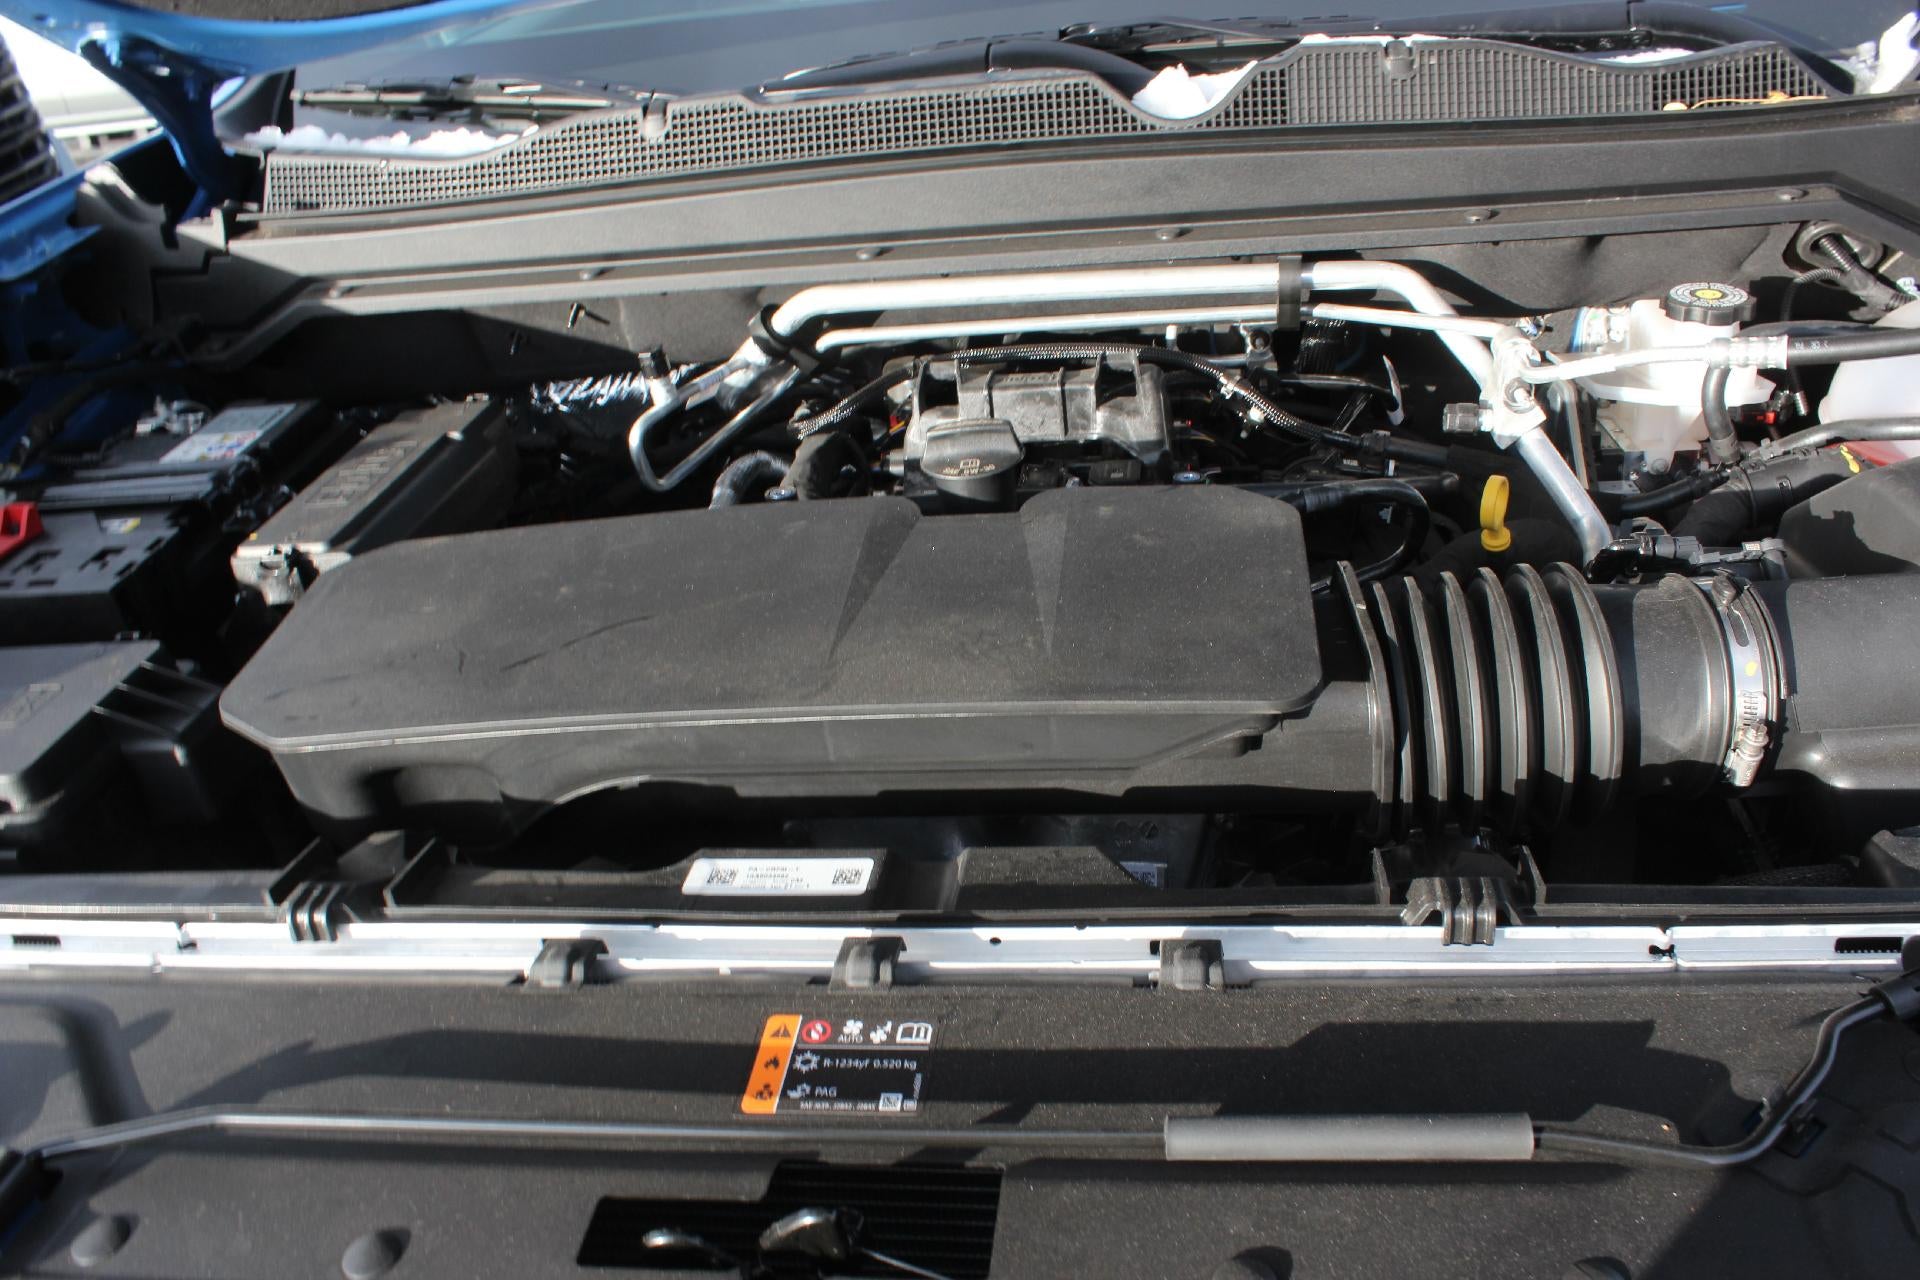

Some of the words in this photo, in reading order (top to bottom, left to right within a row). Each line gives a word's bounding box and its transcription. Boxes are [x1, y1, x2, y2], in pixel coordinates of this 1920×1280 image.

[837, 1034, 863, 1044] AUTO
[823, 1057, 869, 1070] R-1234yf
[903, 1058, 917, 1071] kg
[815, 1086, 837, 1098] PAG
